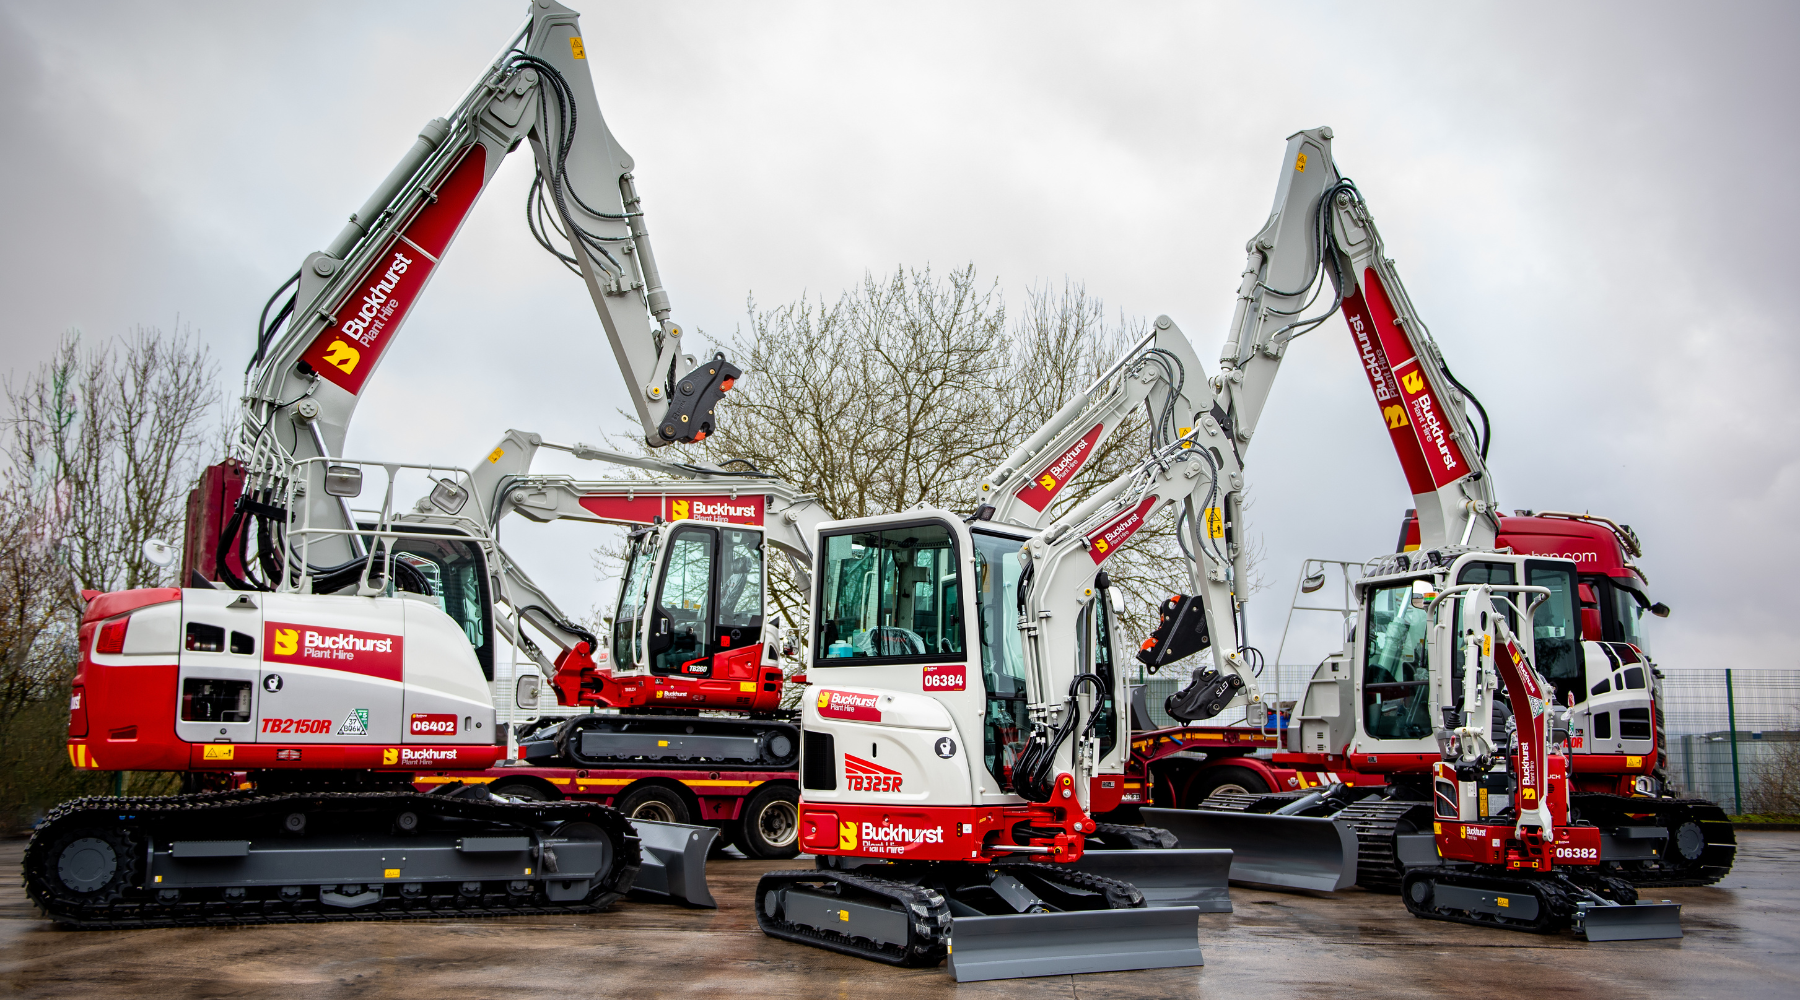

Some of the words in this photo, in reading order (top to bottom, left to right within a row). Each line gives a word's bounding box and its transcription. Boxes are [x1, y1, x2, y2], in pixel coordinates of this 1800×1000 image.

[341, 252, 412, 341] Buckhurst
[359, 319, 385, 348] Plant
[377, 299, 399, 321] Hire
[1349, 313, 1391, 402] Buckhurst
[1376, 348, 1388, 371] Hire
[1382, 371, 1398, 398] Plant
[1411, 399, 1425, 423] Plant
[1421, 421, 1432, 443] Hire
[1418, 393, 1457, 471] Buckhurst
[1049, 438, 1089, 477] Buckhurst
[1056, 468, 1070, 481] Plant
[1067, 459, 1079, 470] Hire
[693, 501, 756, 517] Buckhurst
[693, 514, 713, 522] Plant
[713, 515, 729, 523] Hire
[1104, 513, 1139, 542] Buckhurst
[1109, 536, 1121, 547] Plant
[1119, 530, 1130, 539] Hire
[304, 630, 393, 653] Buckhurst
[304, 647, 331, 659] Plant
[333, 650, 355, 661] Hire
[924, 674, 964, 687] 06384
[830, 703, 844, 712] Plant
[844, 705, 855, 713] Hire
[831, 692, 877, 708] Buckhurst
[261, 718, 332, 734] TB2150R
[412, 720, 455, 732] 06402
[401, 748, 458, 760] Buckhurst
[401, 758, 419, 766] Plant
[1520, 741, 1531, 786] Buckhurst
[845, 774, 903, 793] TB325R
[862, 822, 944, 843] Buckhurst
[1466, 825, 1487, 837] Buckhurst
[862, 840, 885, 853] Plant
[886, 841, 905, 854] Hire
[1555, 847, 1598, 858] 06382
